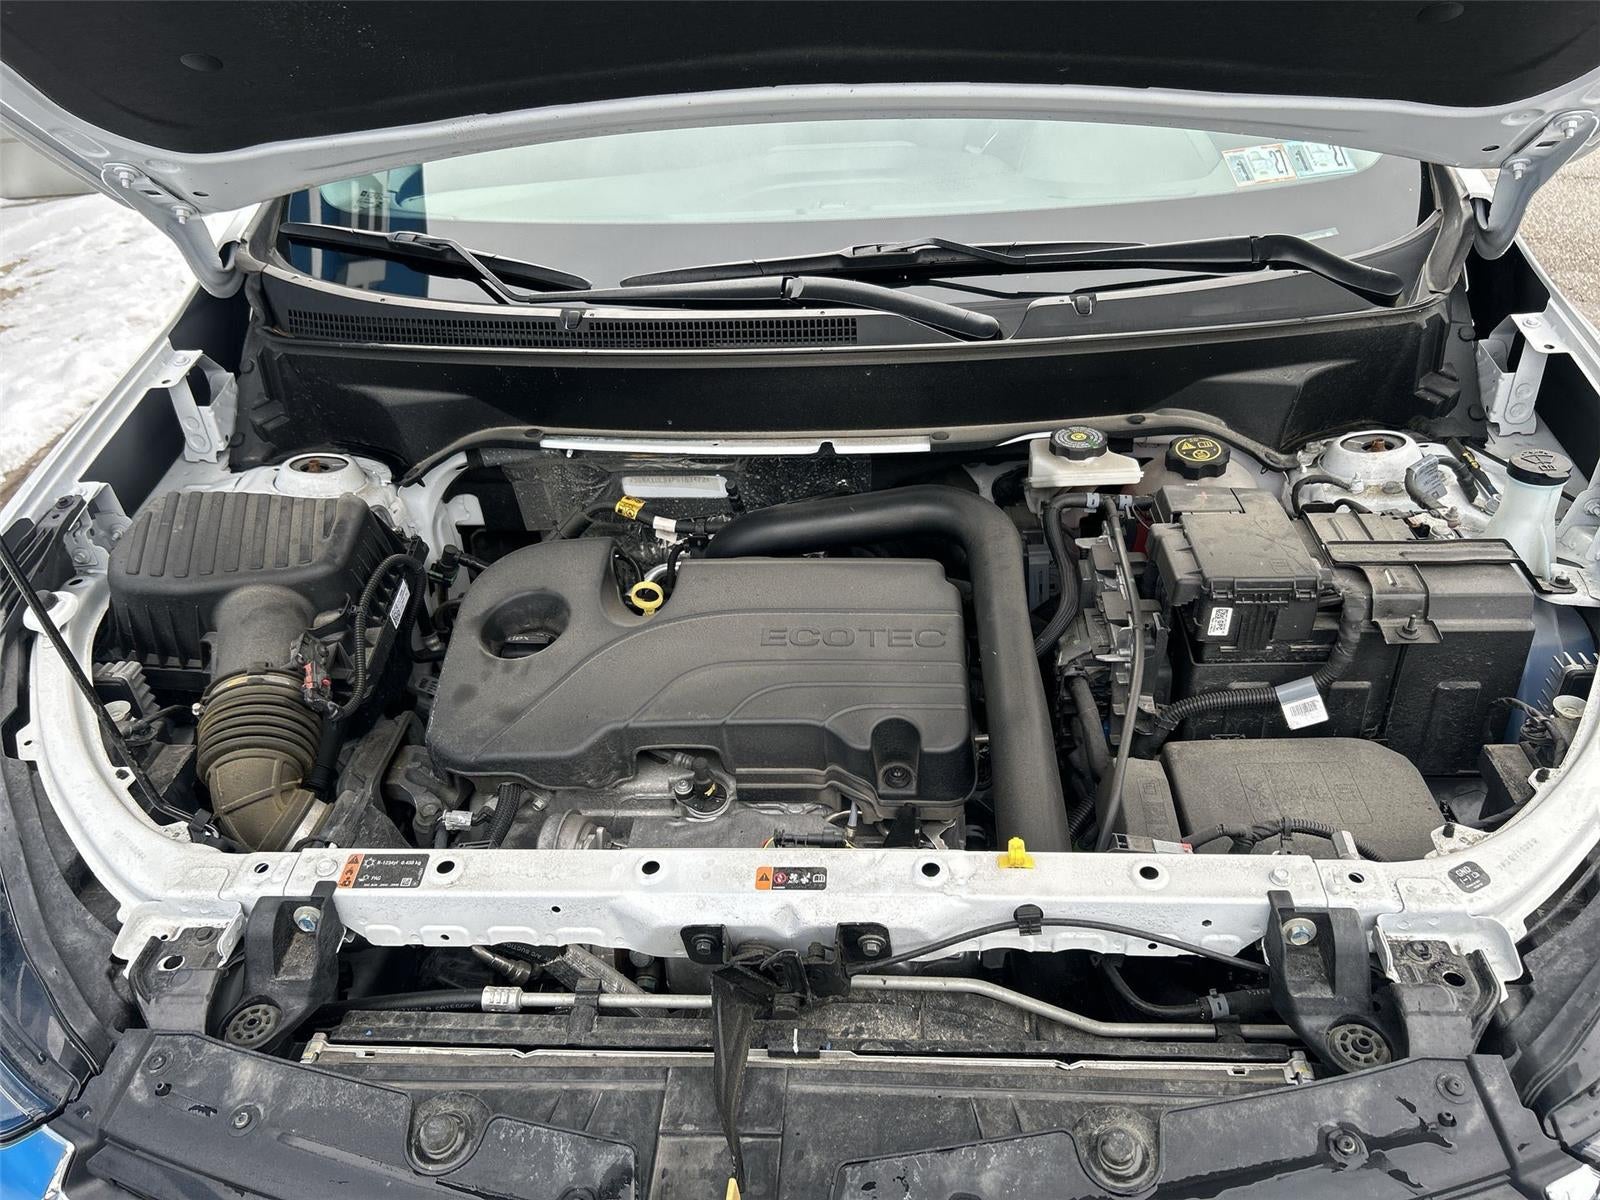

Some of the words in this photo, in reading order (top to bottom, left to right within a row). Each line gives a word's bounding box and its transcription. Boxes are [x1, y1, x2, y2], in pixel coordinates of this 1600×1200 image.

[1269, 149, 1289, 175] 27
[760, 627, 947, 648] ECOTEC
[1455, 865, 1472, 877] GND
